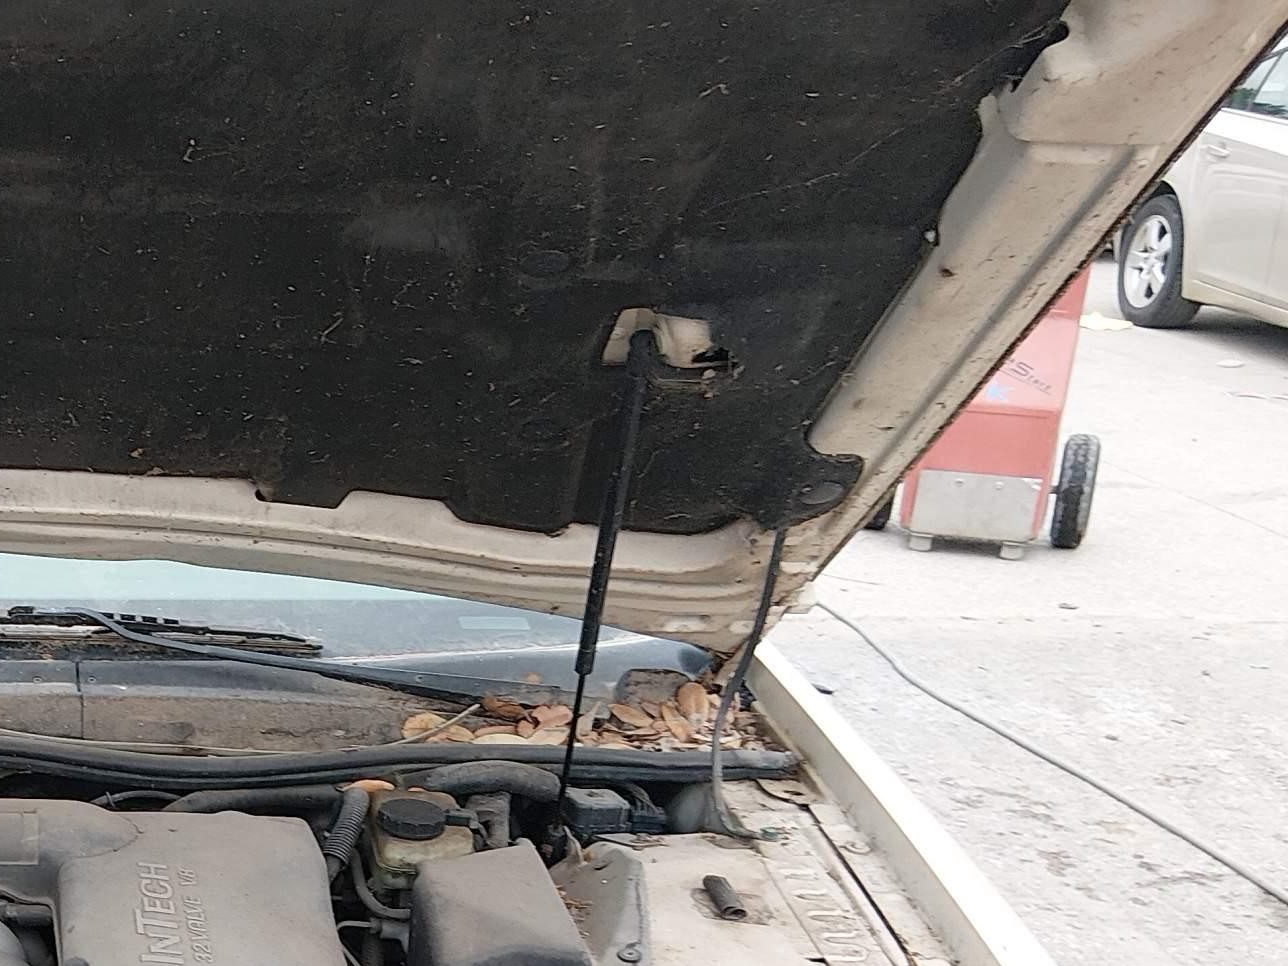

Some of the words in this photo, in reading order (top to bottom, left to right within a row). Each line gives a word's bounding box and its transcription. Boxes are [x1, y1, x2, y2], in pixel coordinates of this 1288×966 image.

[177, 866, 197, 887] V8
[183, 896, 209, 940] VALVE
[191, 942, 214, 964] 32
